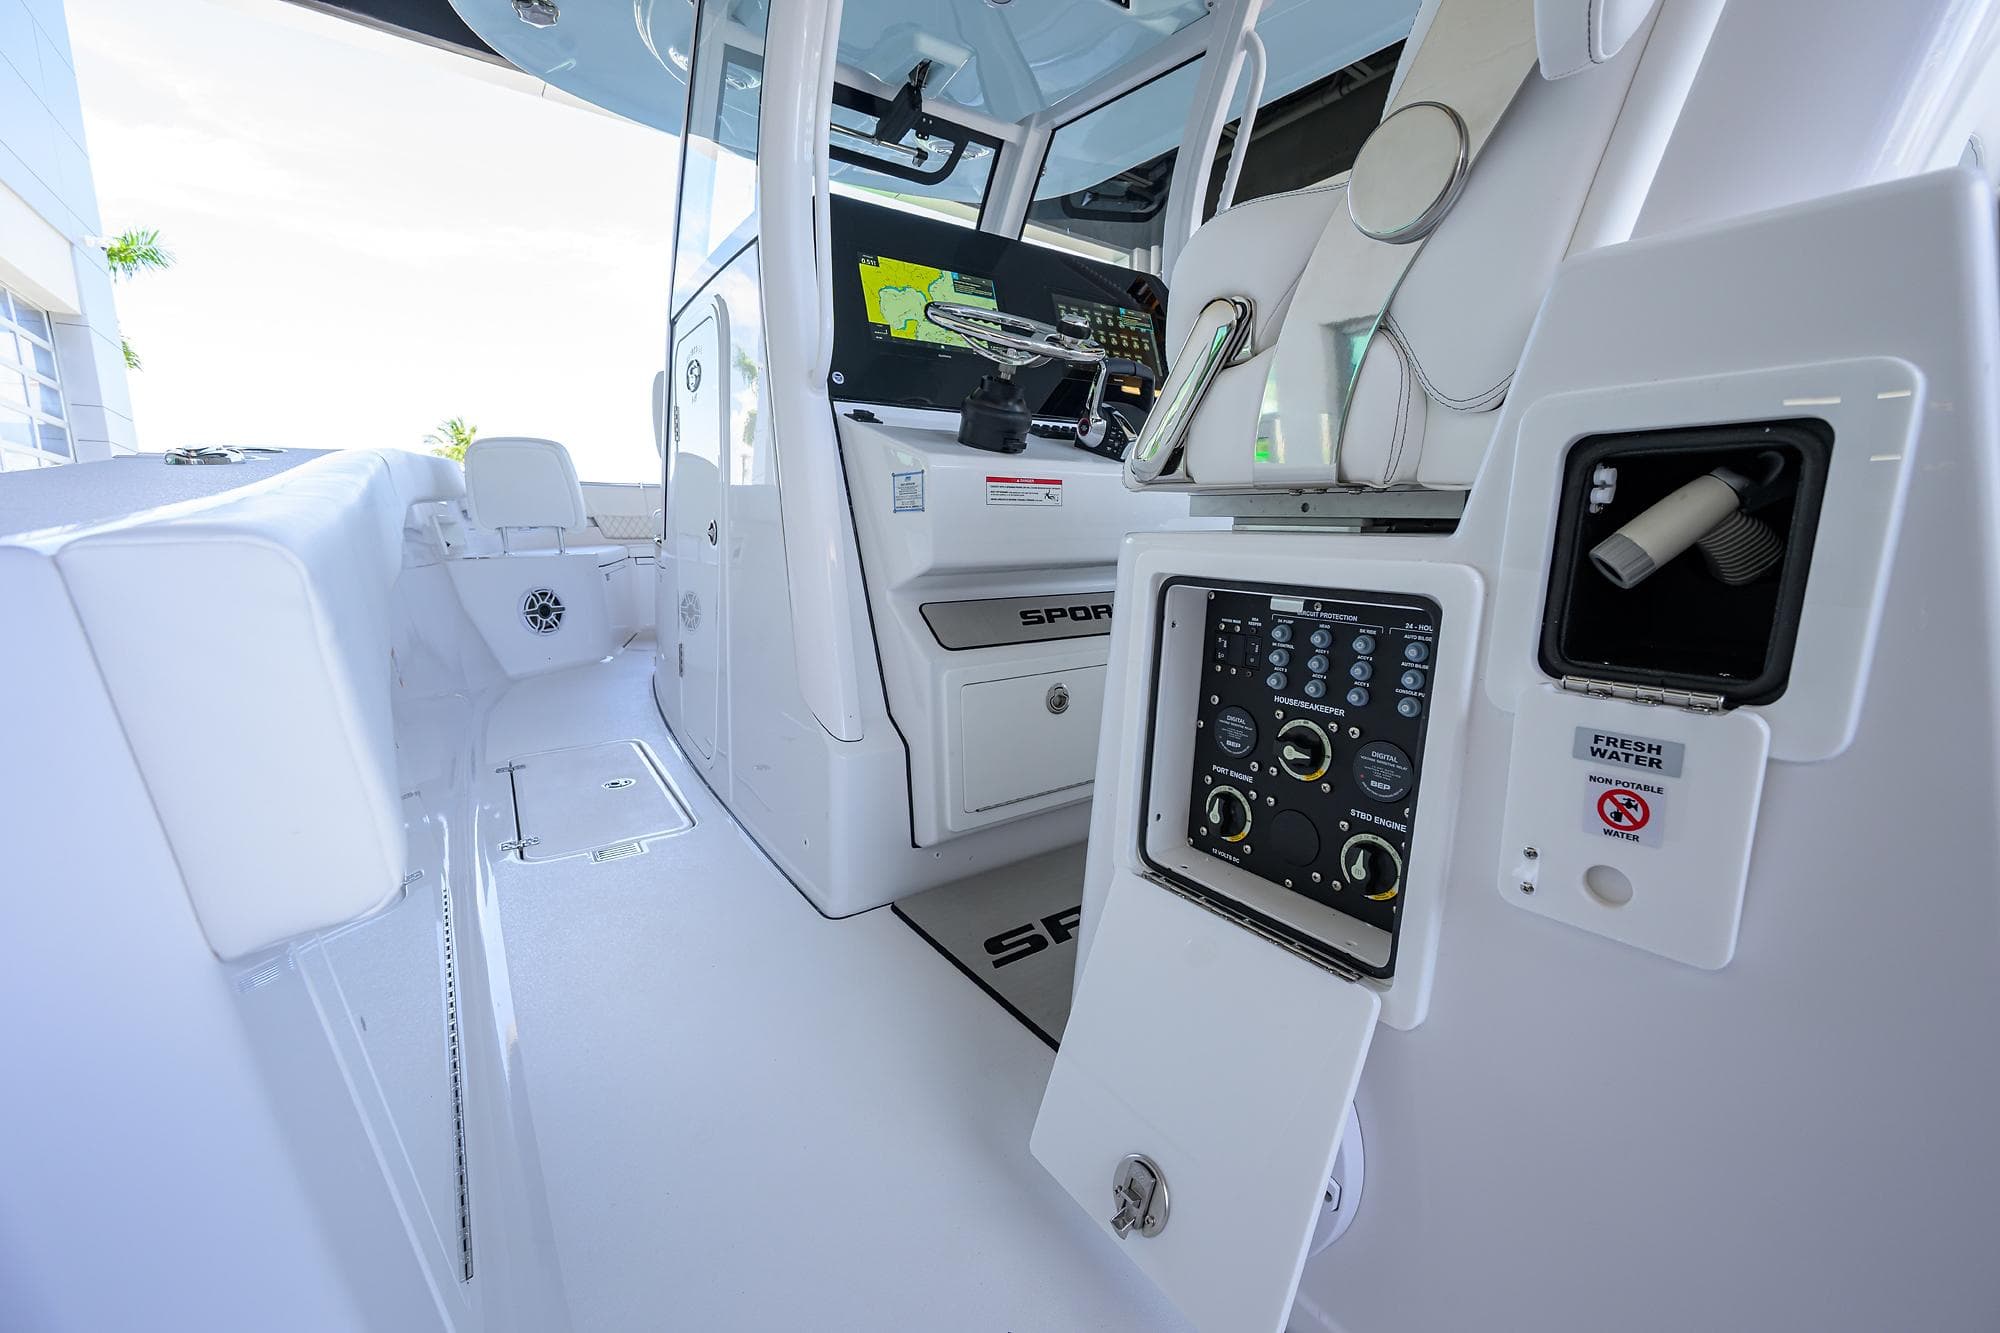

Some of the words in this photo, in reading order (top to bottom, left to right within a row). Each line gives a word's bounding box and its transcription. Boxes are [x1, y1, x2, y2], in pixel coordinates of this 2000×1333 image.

[1019, 604, 1114, 626] SPOR
[1320, 612, 1358, 622] PROTECTION
[1405, 622, 1414, 630] 24
[1395, 688, 1418, 696] CONSOLE
[1274, 695, 1345, 717] HOUSE/SEAKEEPER
[1226, 715, 1246, 725] DIGITAL
[1226, 740, 1241, 748] BEP
[1593, 734, 1662, 756] FRESH
[1371, 751, 1398, 763] DIGITAL
[1590, 746, 1663, 770] WATER
[1212, 764, 1229, 775] PORT
[1229, 770, 1254, 783] ENGINE
[1370, 780, 1391, 790] BEP
[1588, 775, 1613, 785] NON
[1615, 779, 1664, 795] POTABLE
[1350, 808, 1372, 821] STBD
[1374, 816, 1407, 833] ENGINE
[1602, 828, 1640, 843] WATER
[1217, 850, 1232, 861] VOLTS
[1232, 856, 1240, 864] DC
